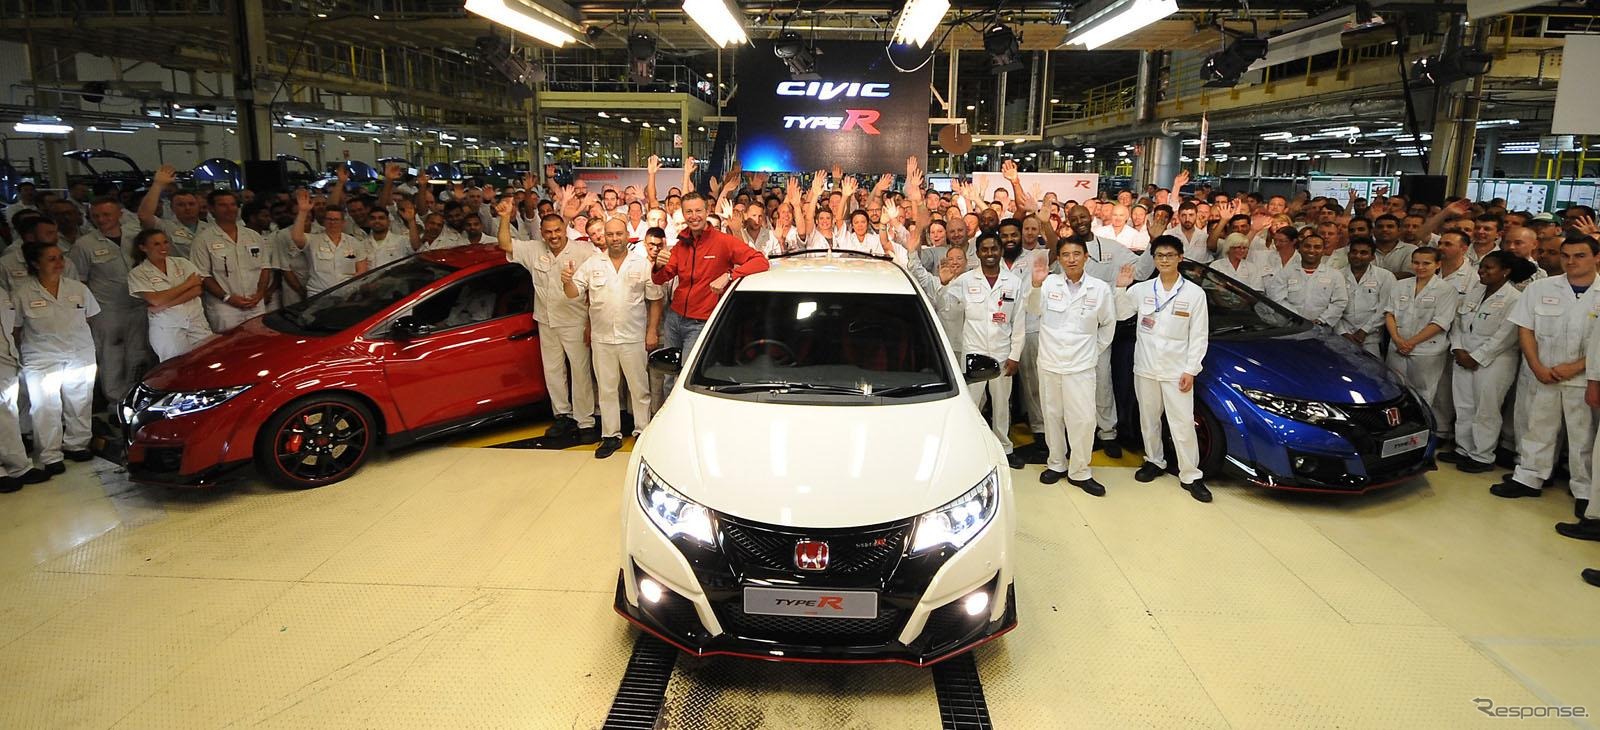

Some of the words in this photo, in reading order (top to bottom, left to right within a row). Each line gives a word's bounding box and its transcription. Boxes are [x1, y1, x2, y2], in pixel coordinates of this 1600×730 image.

[776, 81, 890, 100] CIVIC
[783, 116, 844, 130] TYPE
[842, 108, 881, 135] R
[1074, 180, 1091, 189] R
[775, 598, 817, 607] TYPE
[816, 596, 844, 610] R
